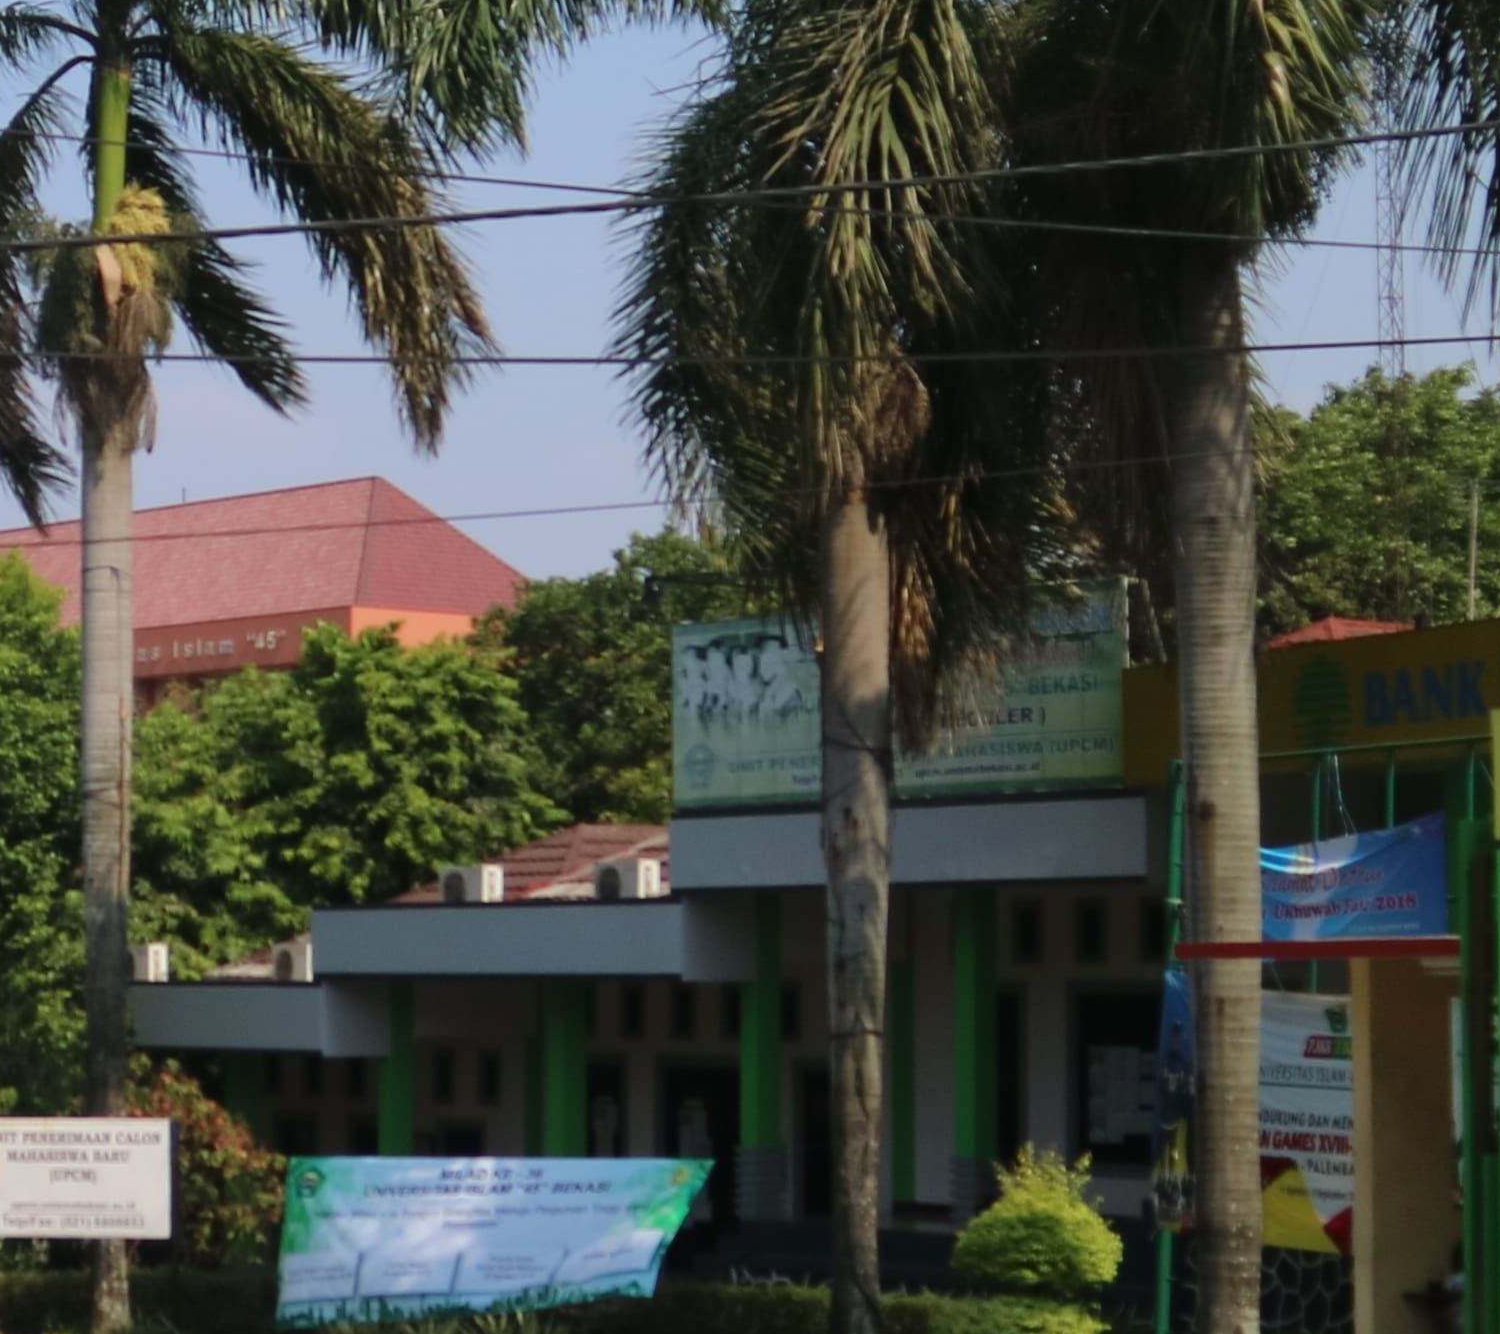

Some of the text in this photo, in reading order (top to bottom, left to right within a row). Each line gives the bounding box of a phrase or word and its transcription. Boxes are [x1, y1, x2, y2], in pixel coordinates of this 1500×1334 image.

[1364, 659, 1490, 727] BANK
[22, 1131, 110, 1145] PENERIMAAN
[116, 1131, 161, 1144] CALON
[1273, 1131, 1315, 1153] GAMES
[7, 1150, 89, 1162] MAHASISWA
